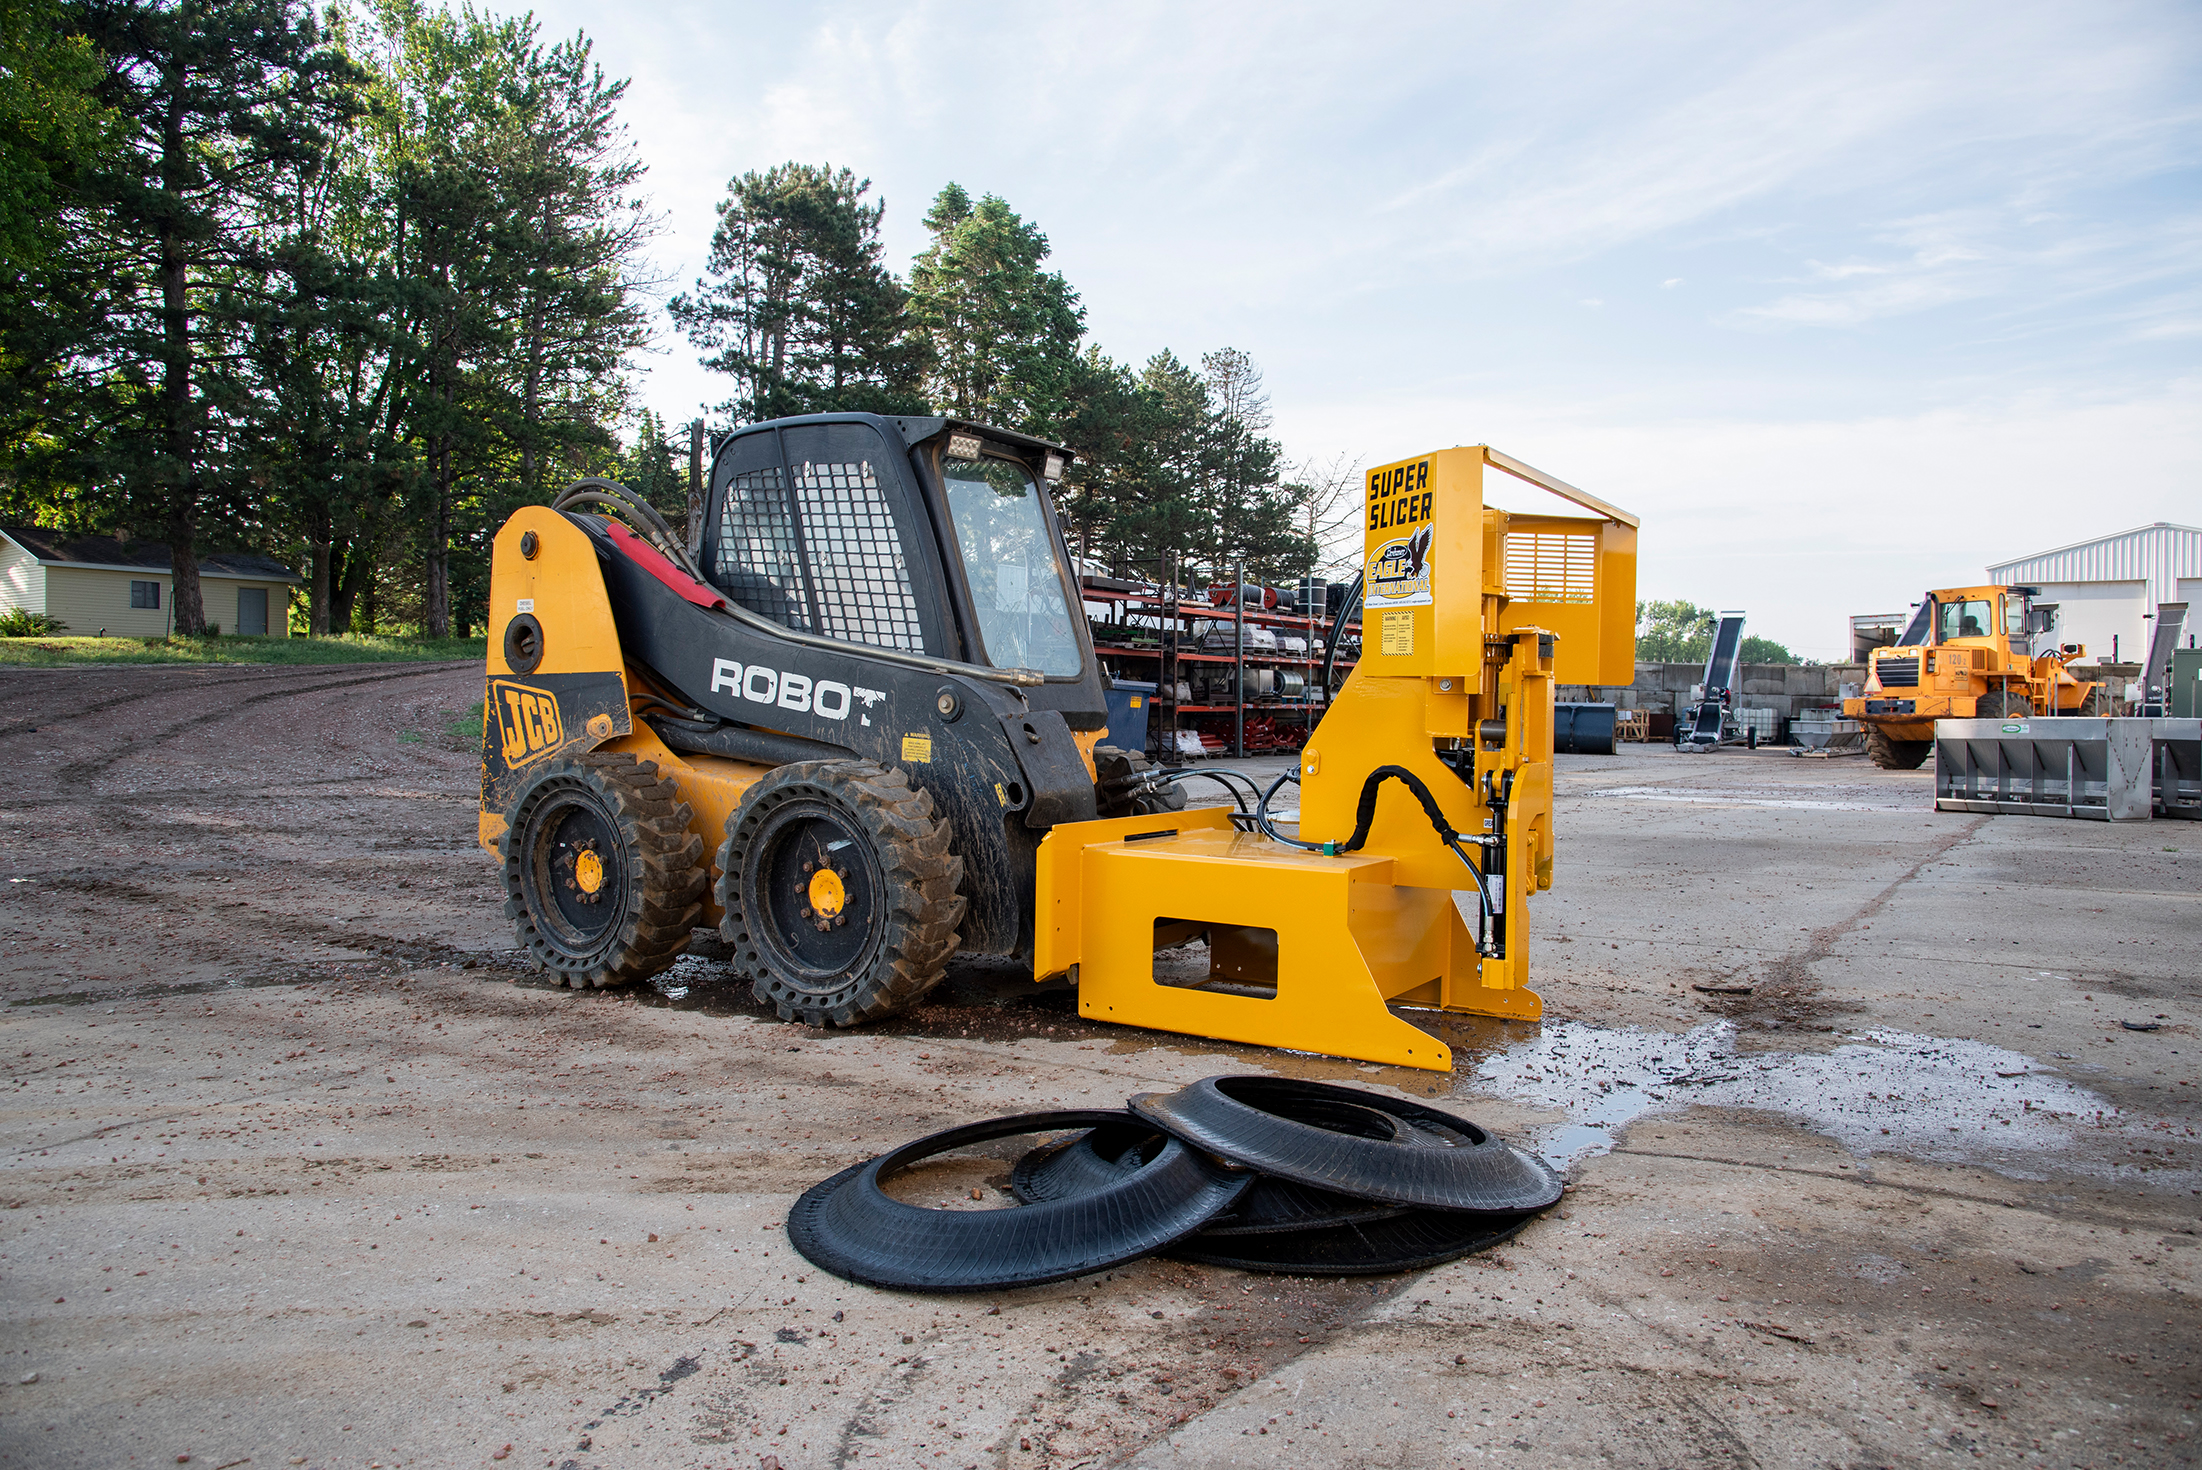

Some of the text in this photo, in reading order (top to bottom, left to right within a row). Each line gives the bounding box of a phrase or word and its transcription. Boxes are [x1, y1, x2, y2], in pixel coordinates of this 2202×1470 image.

[1370, 461, 1429, 501] SUPER
[1369, 492, 1433, 531] SLICER
[1368, 558, 1406, 580] EAGLE
[1368, 578, 1430, 597] INTERNATIONAL
[710, 657, 887, 727] ROBOT
[504, 689, 558, 759] JCB
